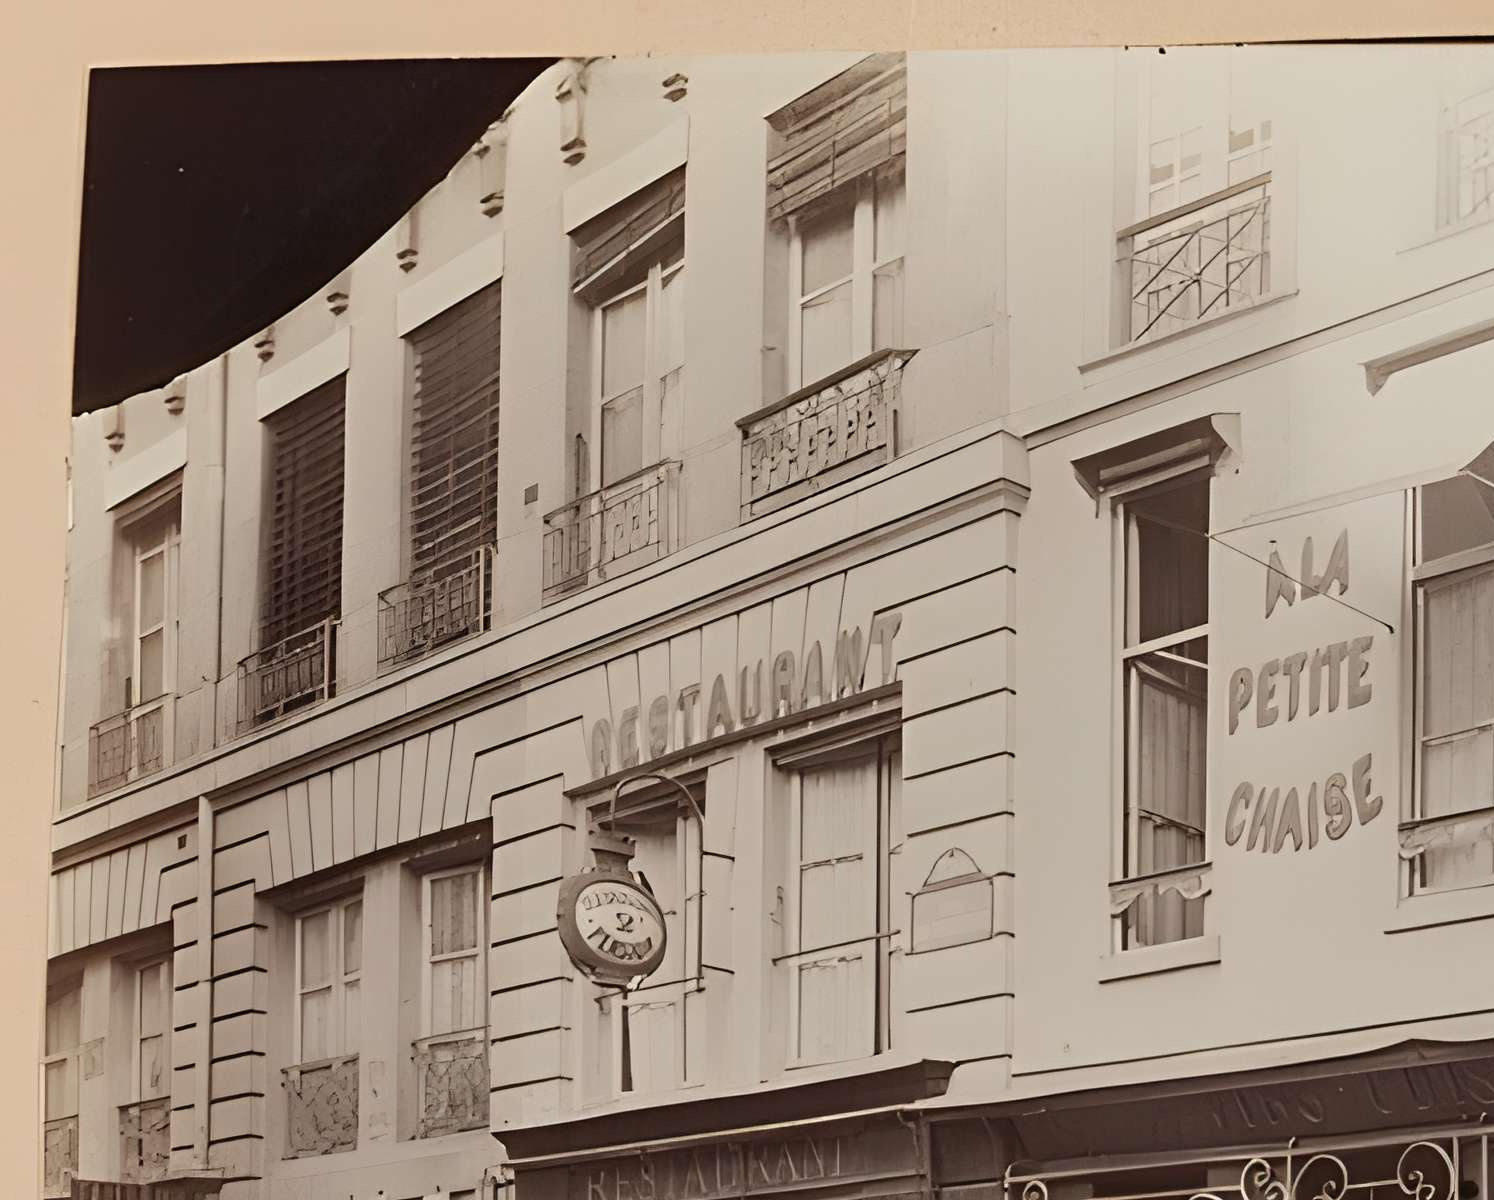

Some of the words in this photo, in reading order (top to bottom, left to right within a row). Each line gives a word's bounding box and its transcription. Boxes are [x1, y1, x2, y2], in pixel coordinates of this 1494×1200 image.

[1300, 526, 1349, 602] LA
[590, 612, 903, 781] RESTAURANT
[1228, 635, 1375, 736] PETITE
[1224, 751, 1384, 855] CHAISE
